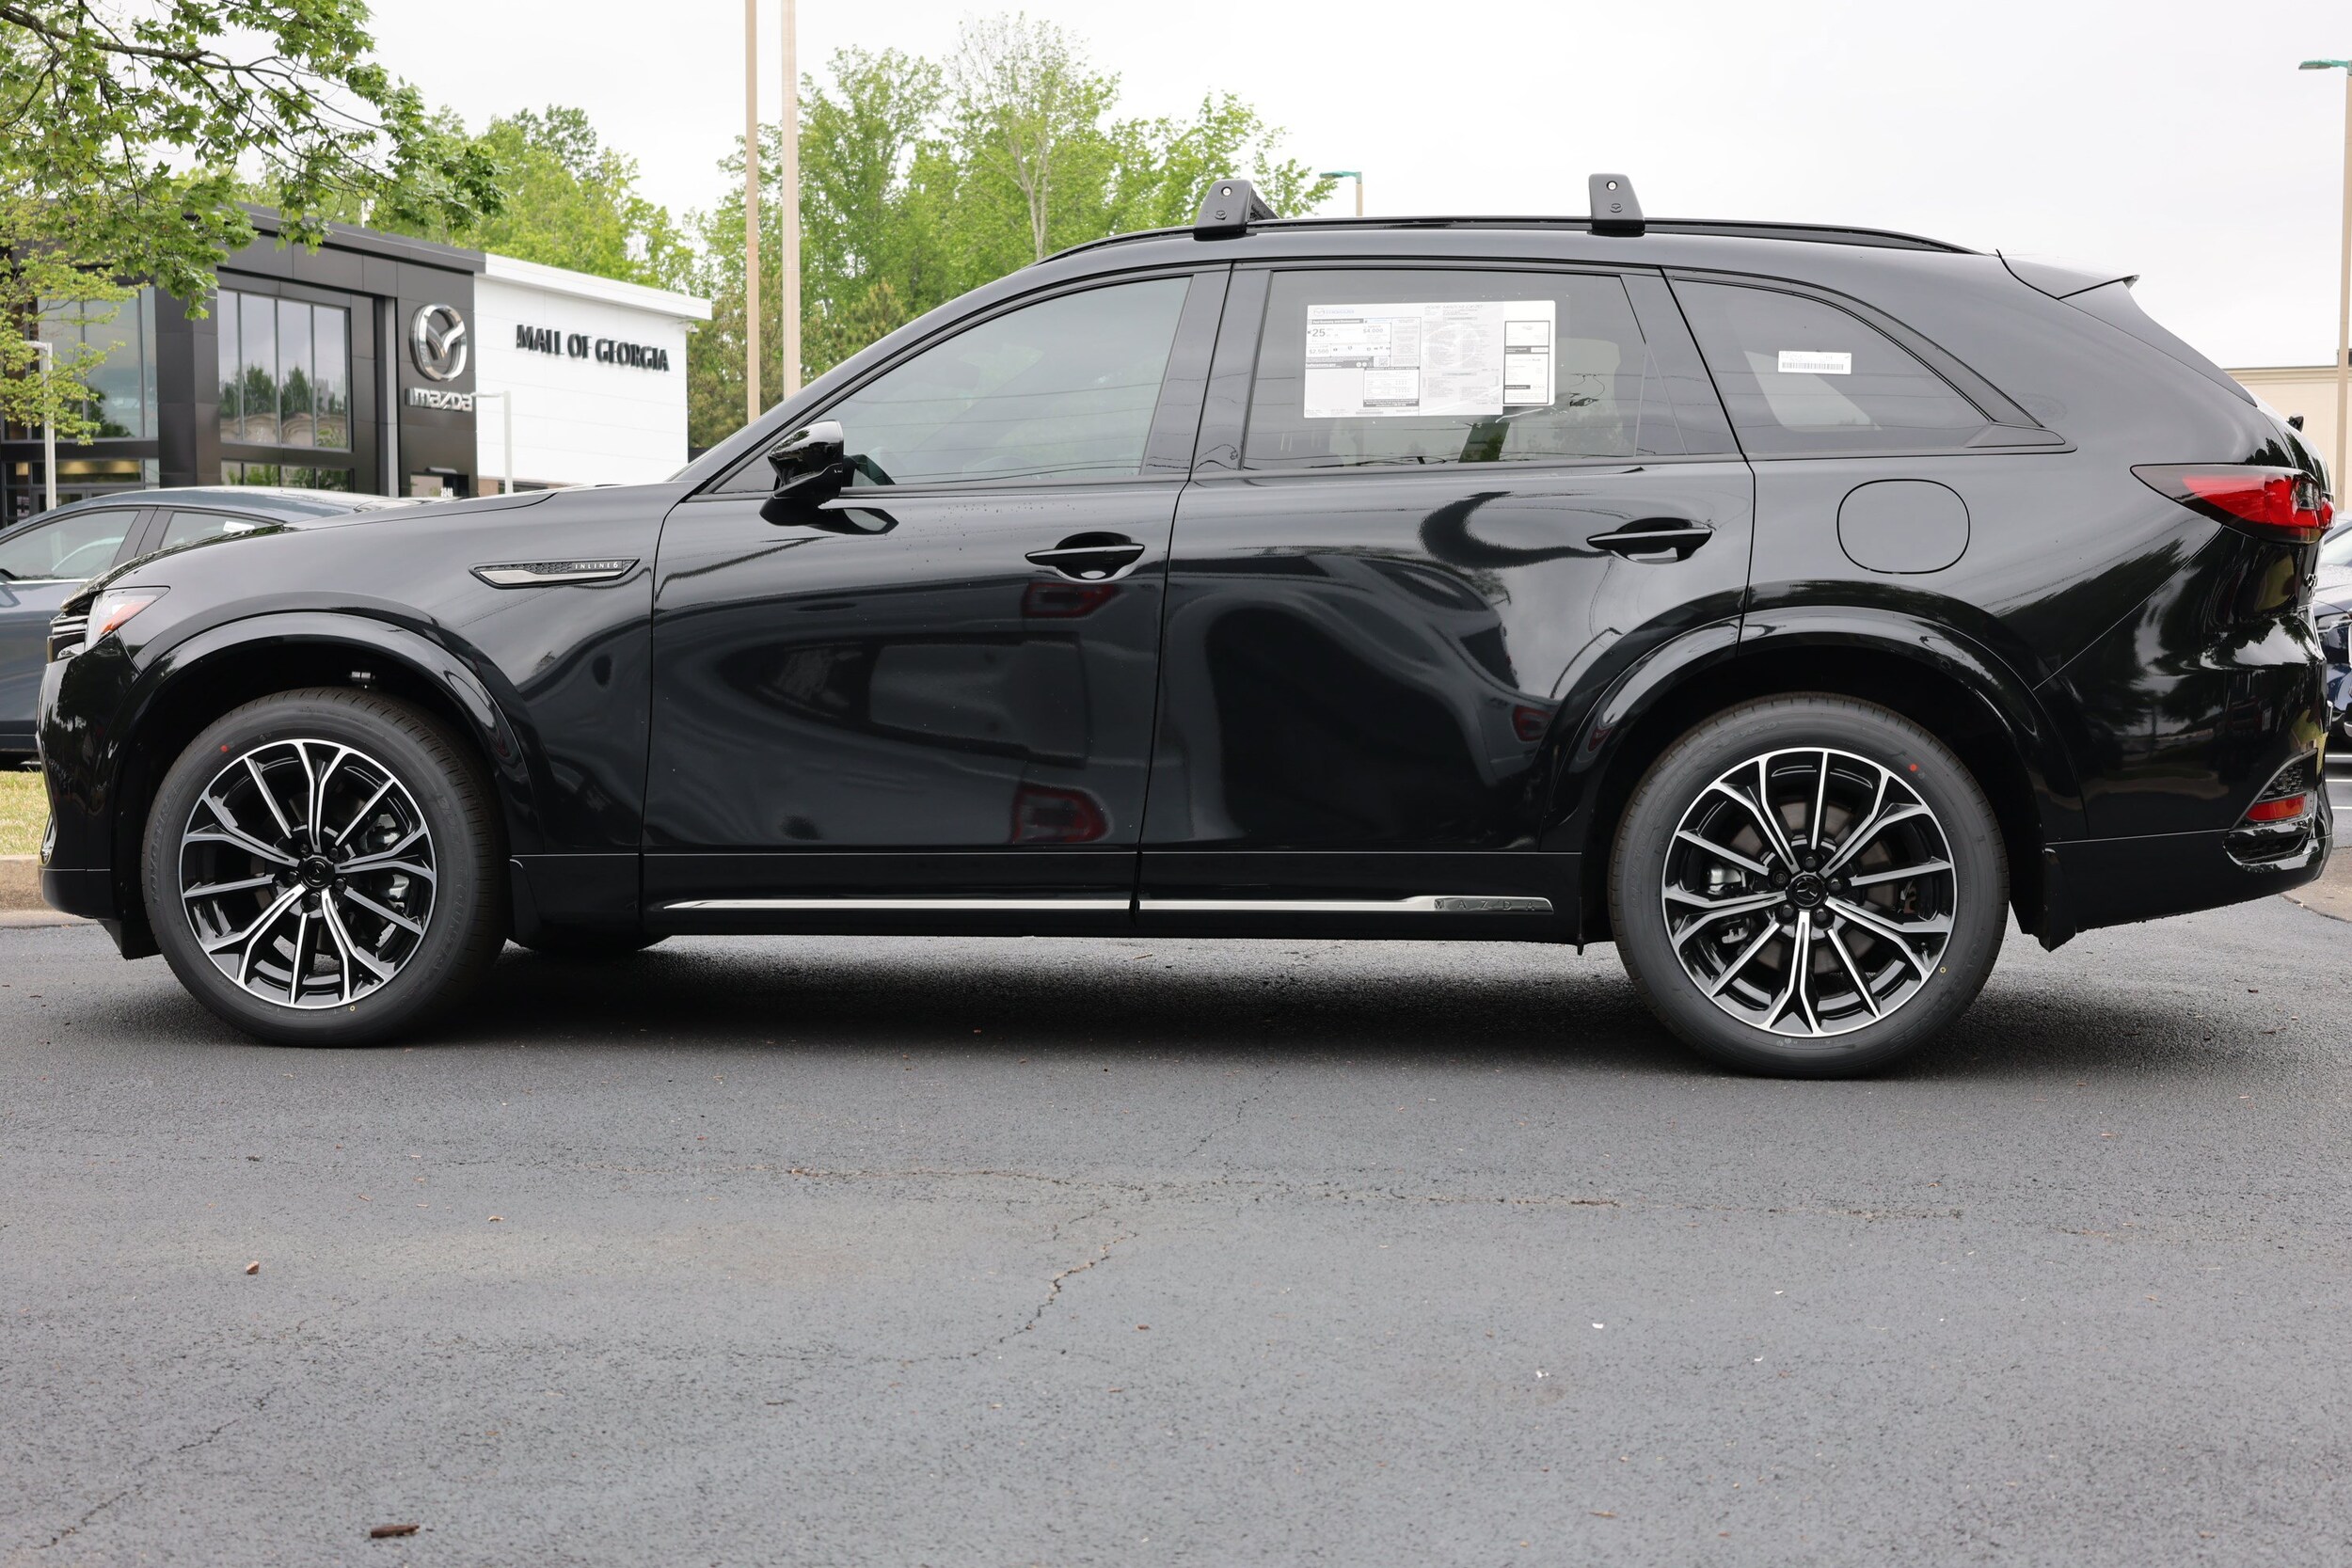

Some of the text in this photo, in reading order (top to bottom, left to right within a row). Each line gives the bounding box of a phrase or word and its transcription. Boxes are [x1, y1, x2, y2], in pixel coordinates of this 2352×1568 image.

[516, 325, 670, 372] MALL OF GEORGIA
[1434, 899, 1535, 911] MAZDA
